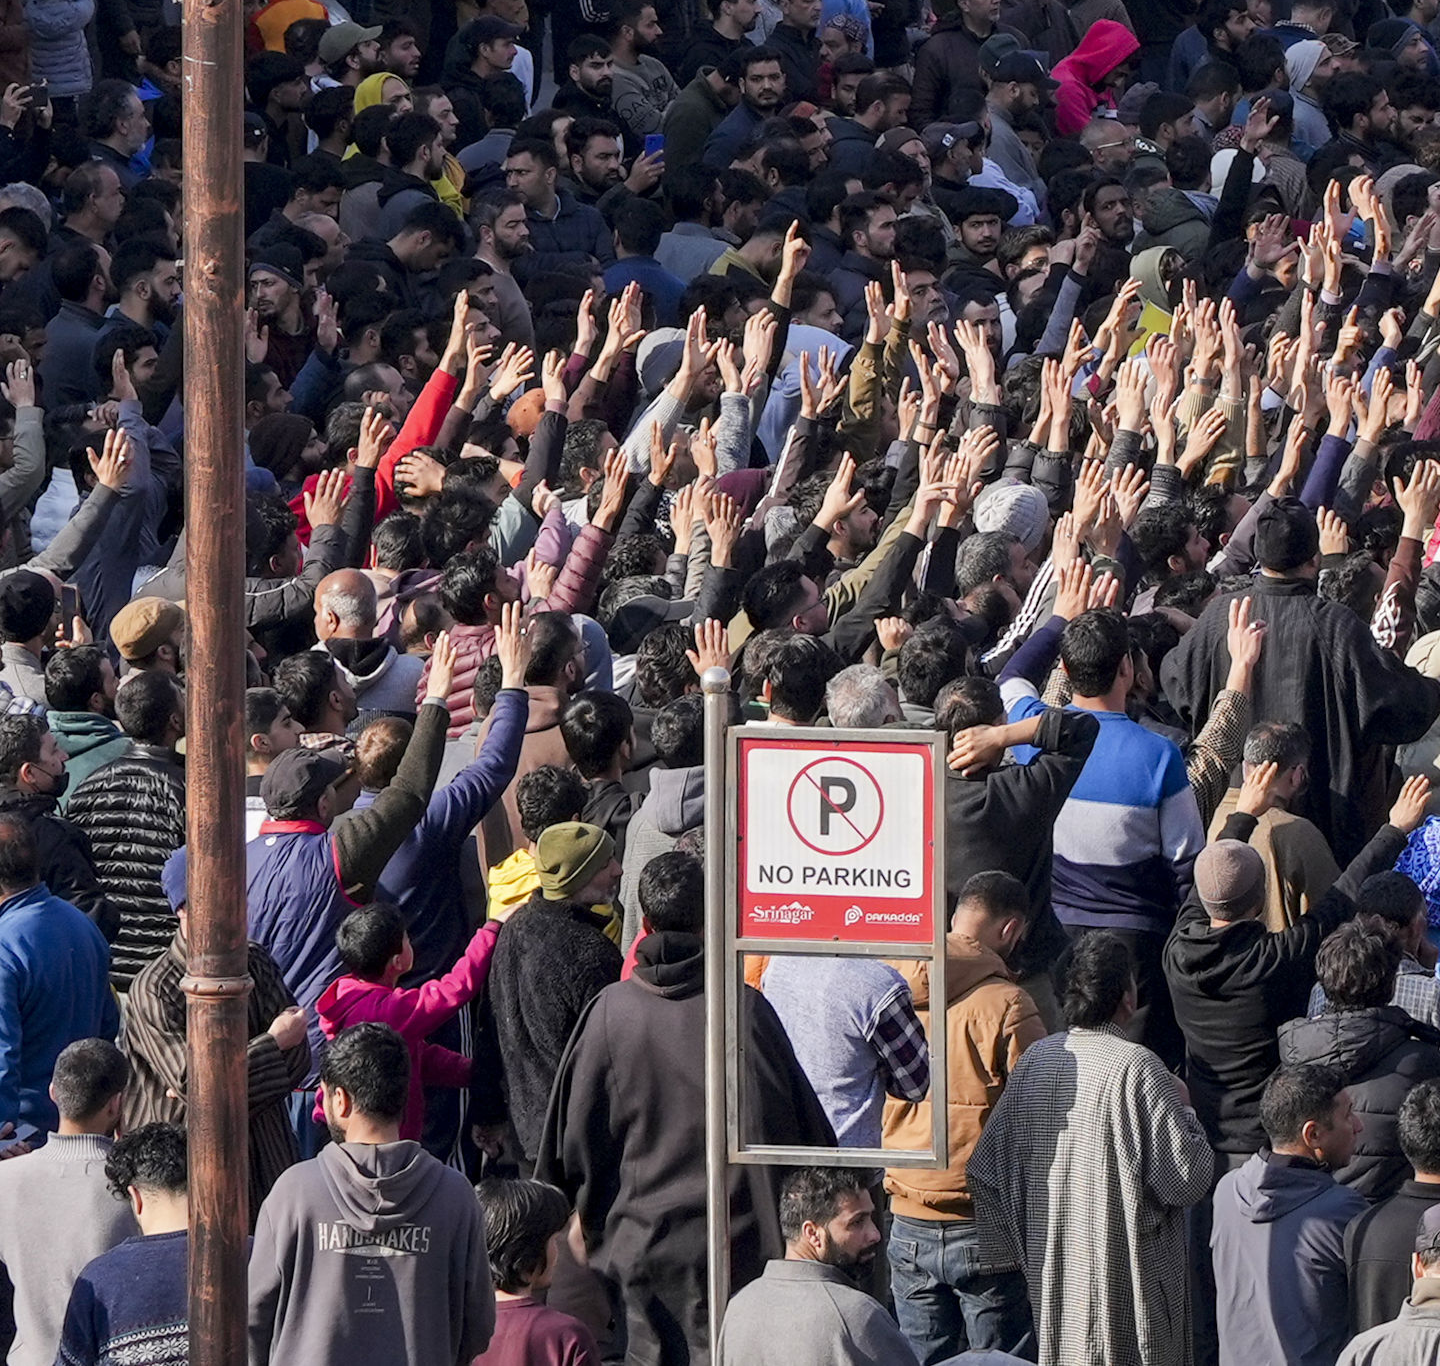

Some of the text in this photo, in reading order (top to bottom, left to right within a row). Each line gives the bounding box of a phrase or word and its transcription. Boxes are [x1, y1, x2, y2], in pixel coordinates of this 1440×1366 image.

[820, 776, 857, 836] P
[759, 865, 911, 888] NO PARKING
[749, 905, 815, 924] Srinagar
[318, 1222, 432, 1253] HANDSHAKES
